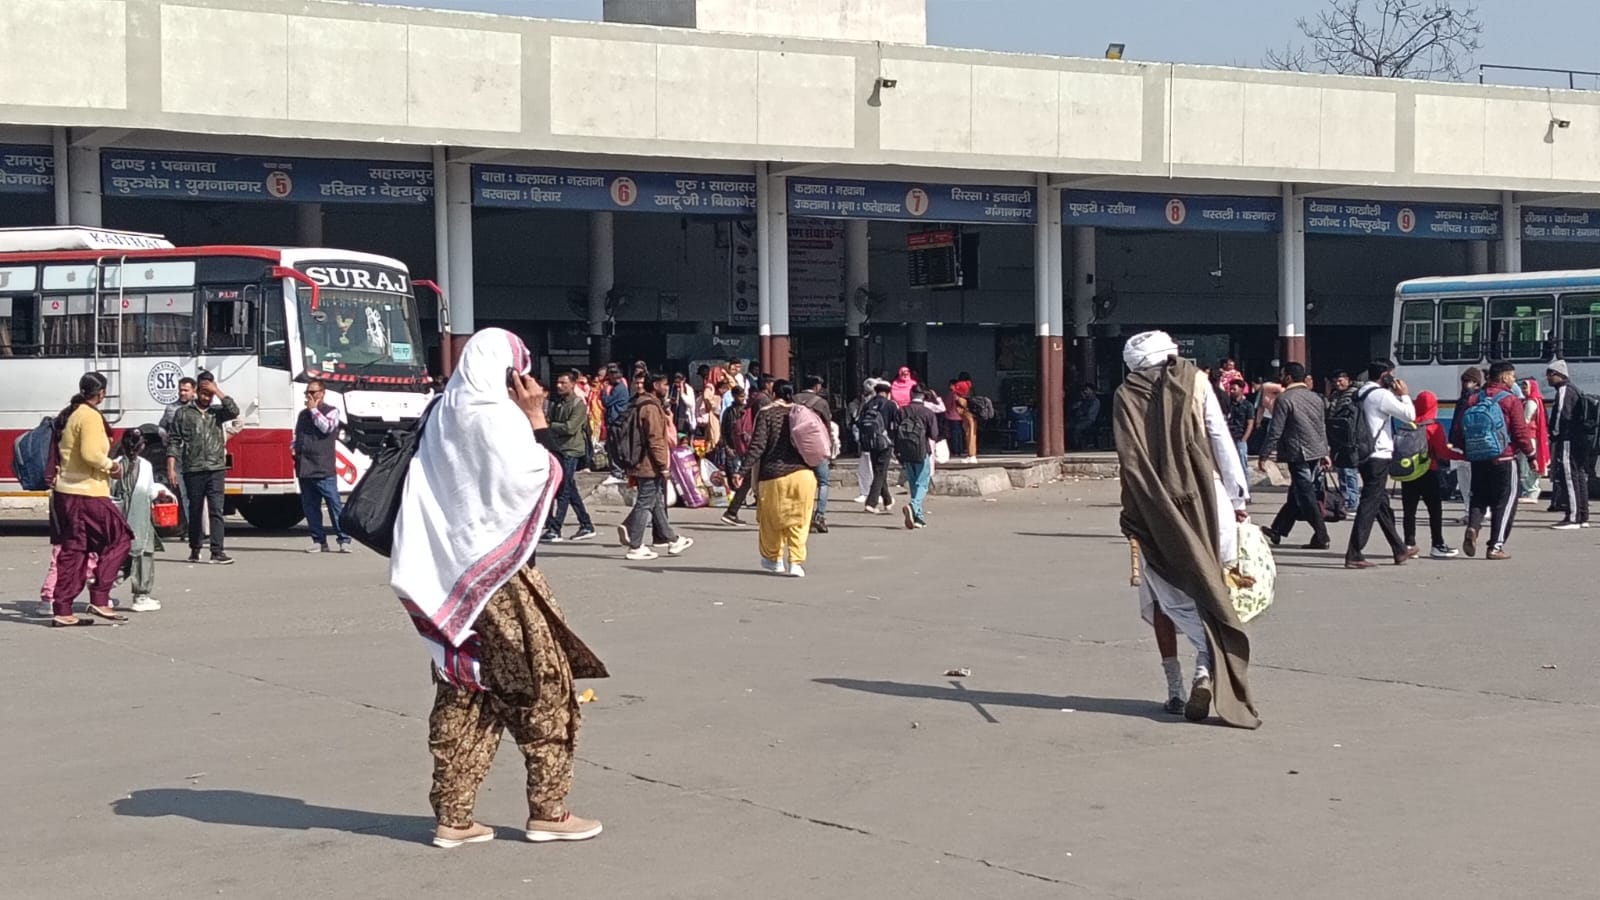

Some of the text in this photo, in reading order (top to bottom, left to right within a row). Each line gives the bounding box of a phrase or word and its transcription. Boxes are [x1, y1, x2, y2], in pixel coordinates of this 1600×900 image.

[111, 158, 145, 171] ढाण्ड
[368, 168, 433, 185] सहारनपुर
[320, 180, 367, 196] हरिद्वार
[380, 183, 433, 201] देहरादून
[531, 187, 562, 202] हिसार
[709, 181, 757, 193] सालासर
[305, 266, 408, 293] SURAJ
[156, 372, 176, 390] SK
